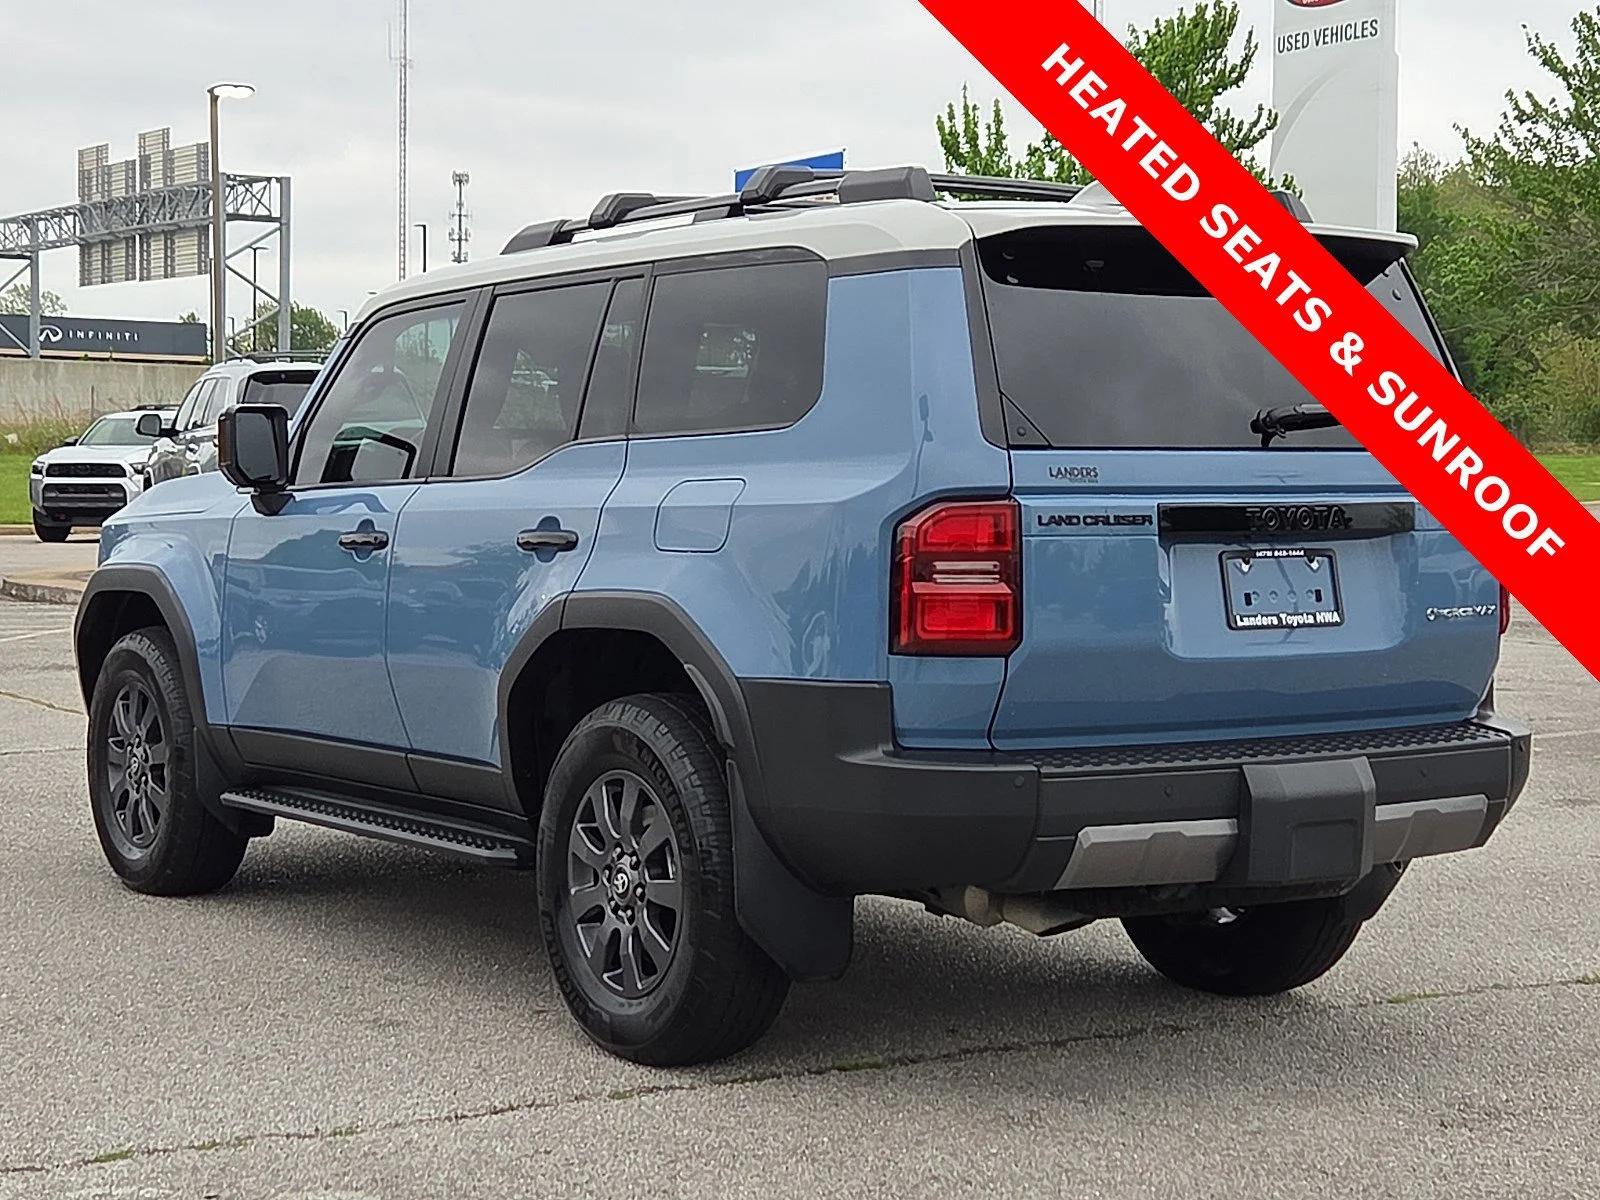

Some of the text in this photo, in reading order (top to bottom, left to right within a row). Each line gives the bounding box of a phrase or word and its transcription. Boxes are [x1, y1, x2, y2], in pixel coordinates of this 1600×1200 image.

[1277, 18, 1379, 54] USED VEHICLES
[68, 329, 139, 342] INFINITI
[1048, 466, 1099, 479] LANDERS
[1037, 514, 1154, 526] LAND CRUISER
[1245, 505, 1347, 531] TOYOTA
[1236, 610, 1341, 627] Landers Toyota NWA
[640, 748, 690, 848] MICHELIN
